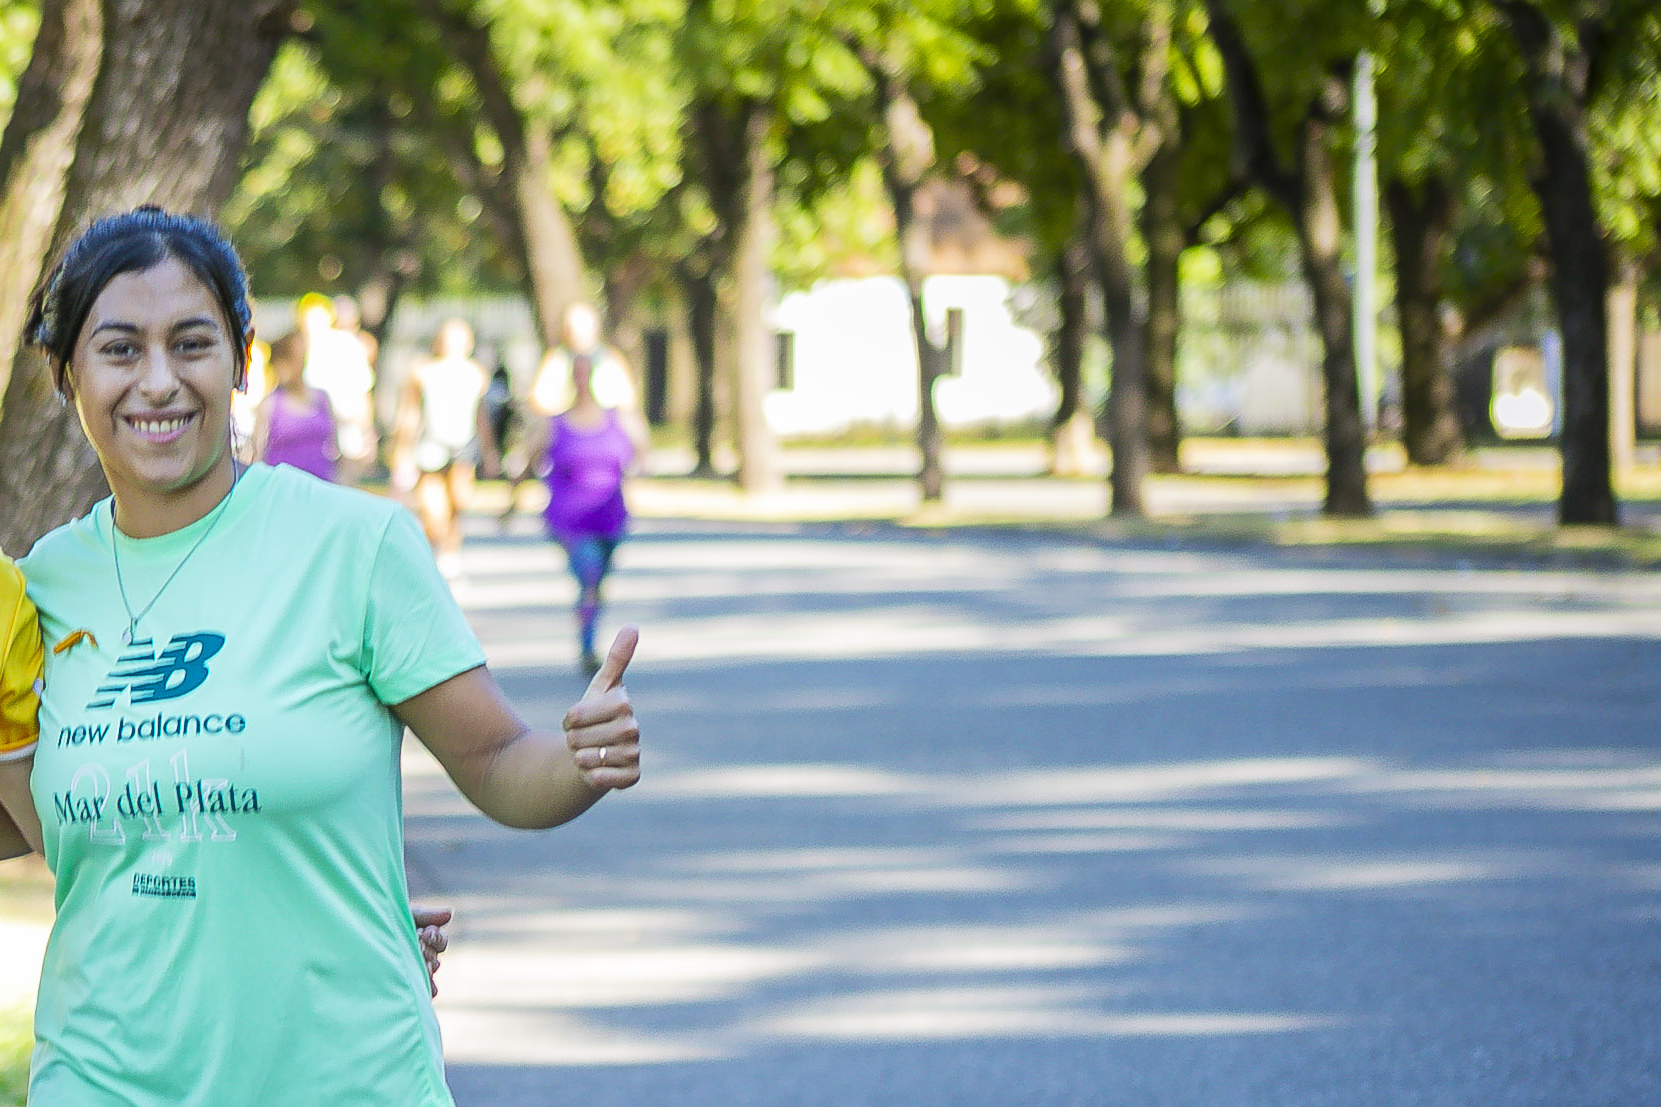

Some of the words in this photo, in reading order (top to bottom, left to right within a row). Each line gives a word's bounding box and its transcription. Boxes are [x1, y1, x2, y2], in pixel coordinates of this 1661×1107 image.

[57, 723, 109, 749] new
[117, 711, 246, 743] balance
[53, 788, 105, 826] Mar
[117, 779, 163, 819] del
[174, 778, 262, 816] Plata
